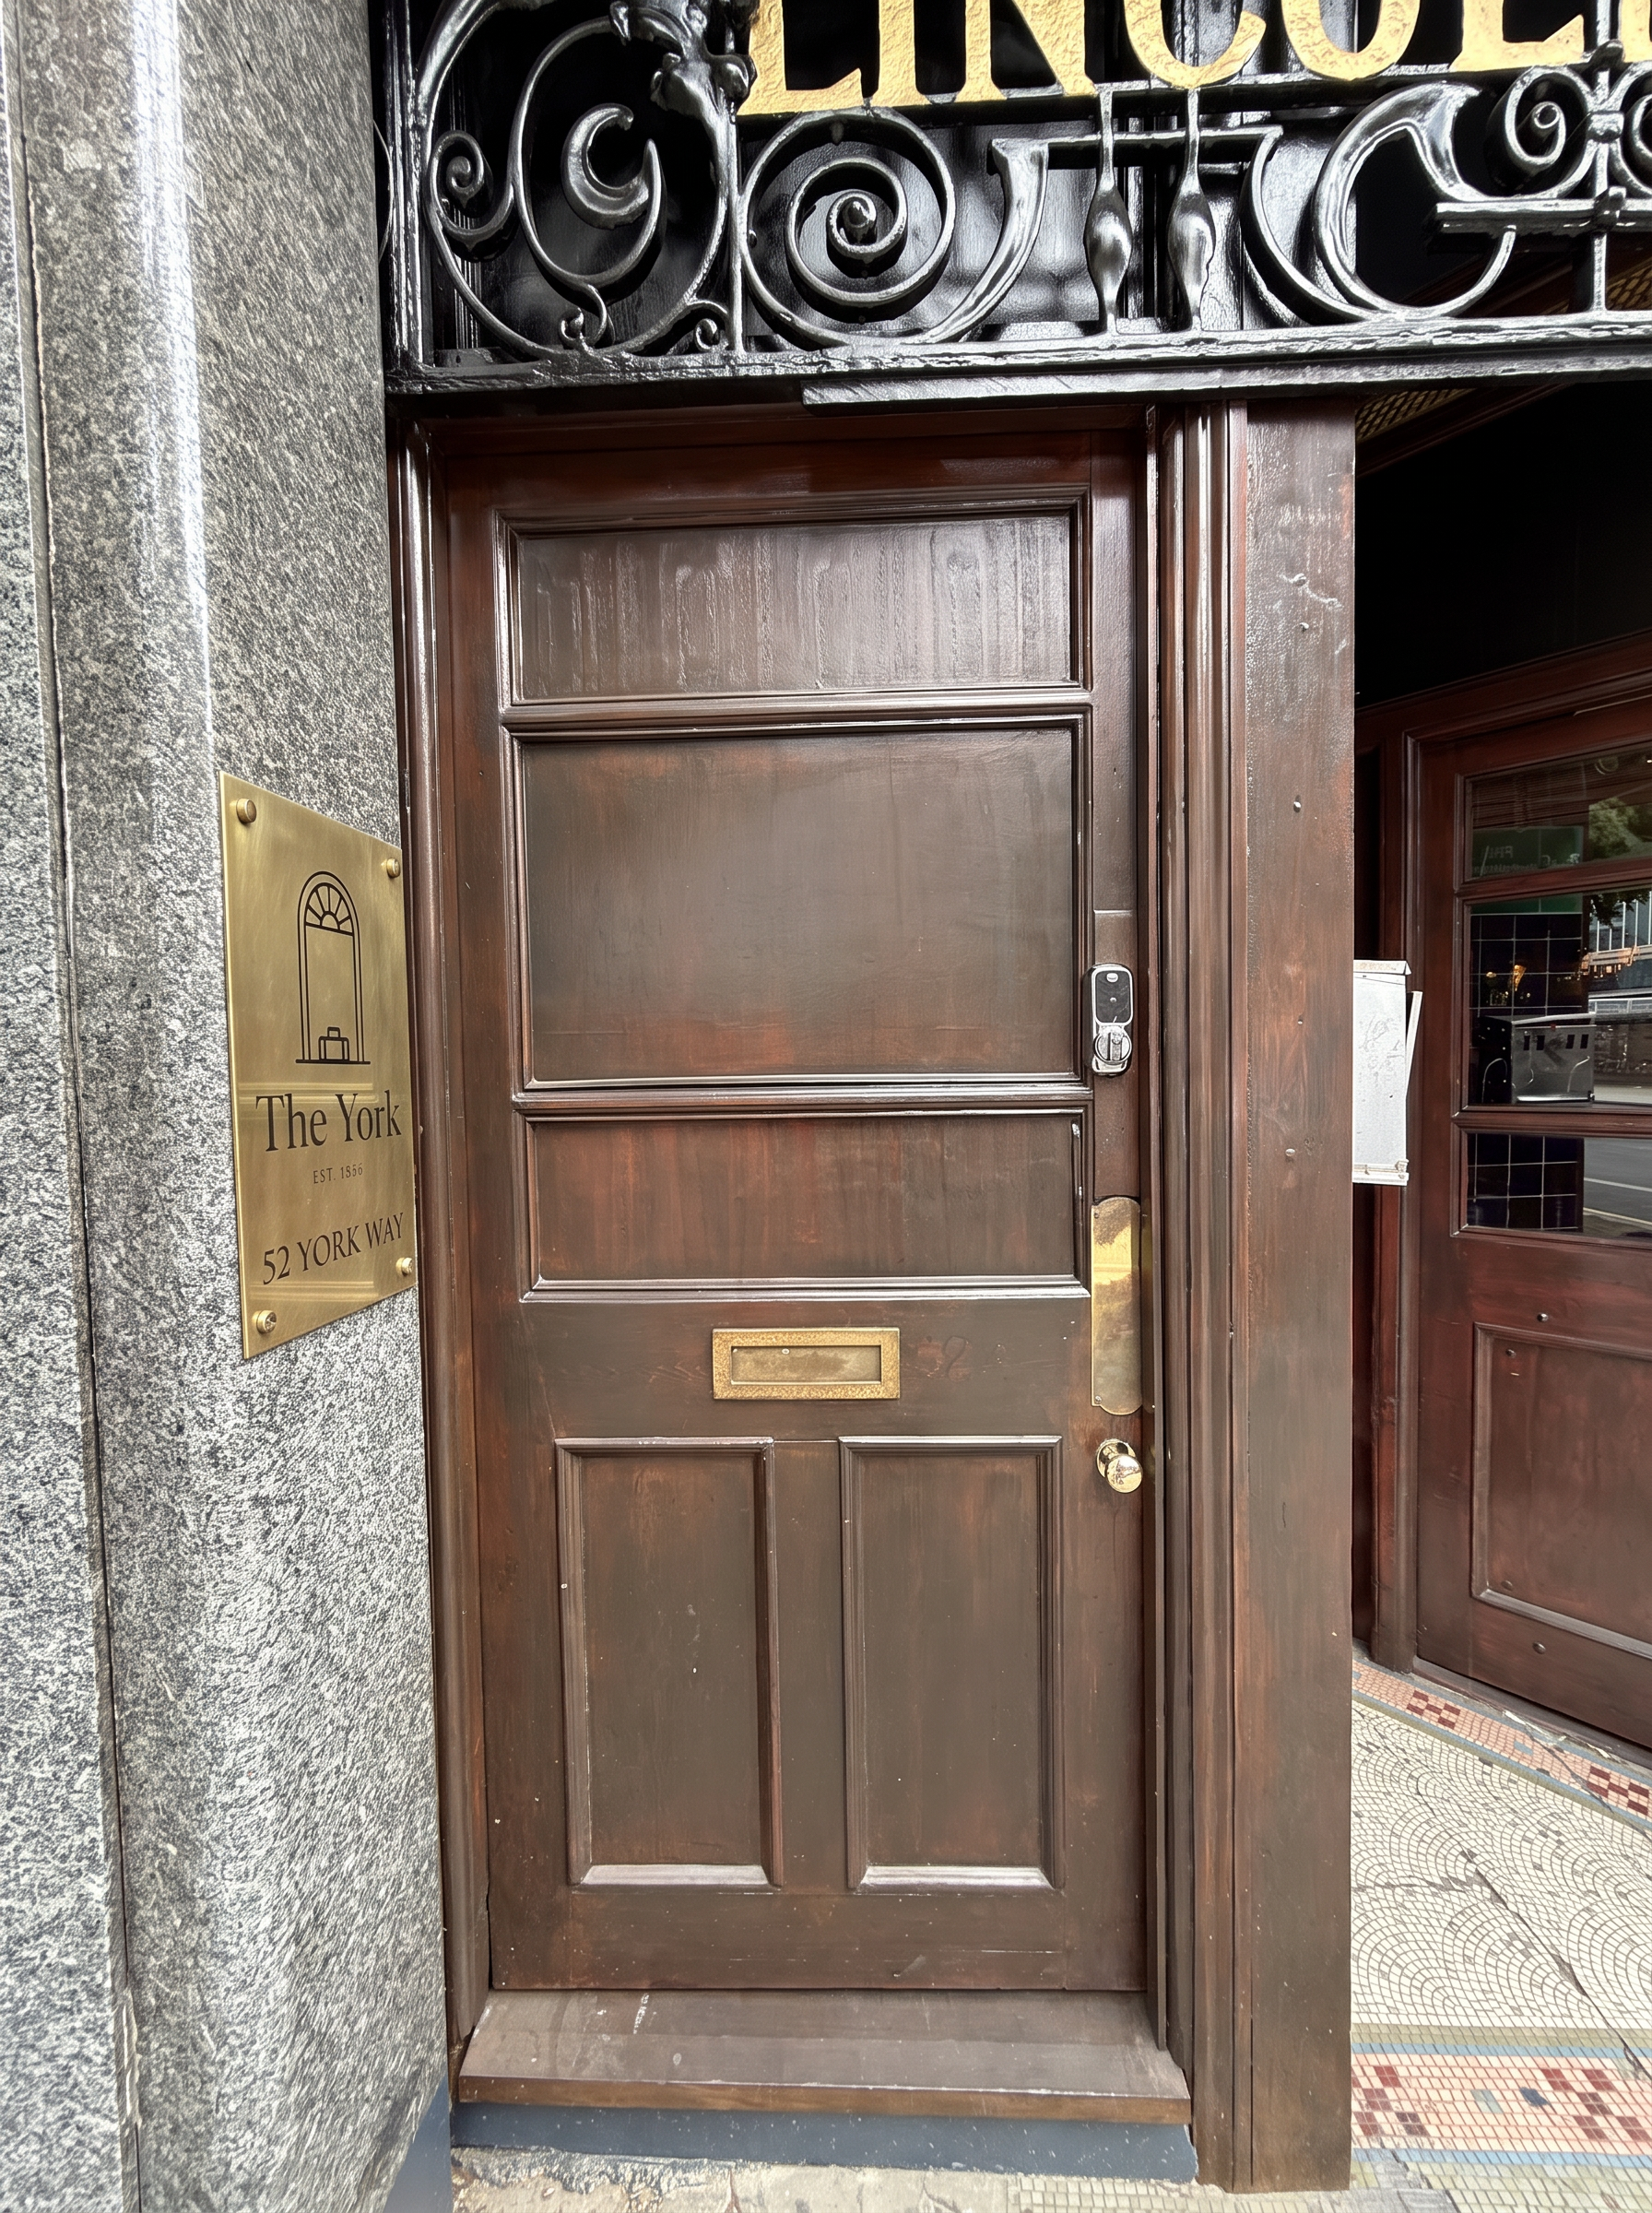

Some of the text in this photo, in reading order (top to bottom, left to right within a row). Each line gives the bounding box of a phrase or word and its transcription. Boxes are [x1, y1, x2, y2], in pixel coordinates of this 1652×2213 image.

[255, 1089, 401, 1152] The York
[313, 1167, 336, 1184] EST.
[263, 1212, 404, 1285] 52 YORK WAY
